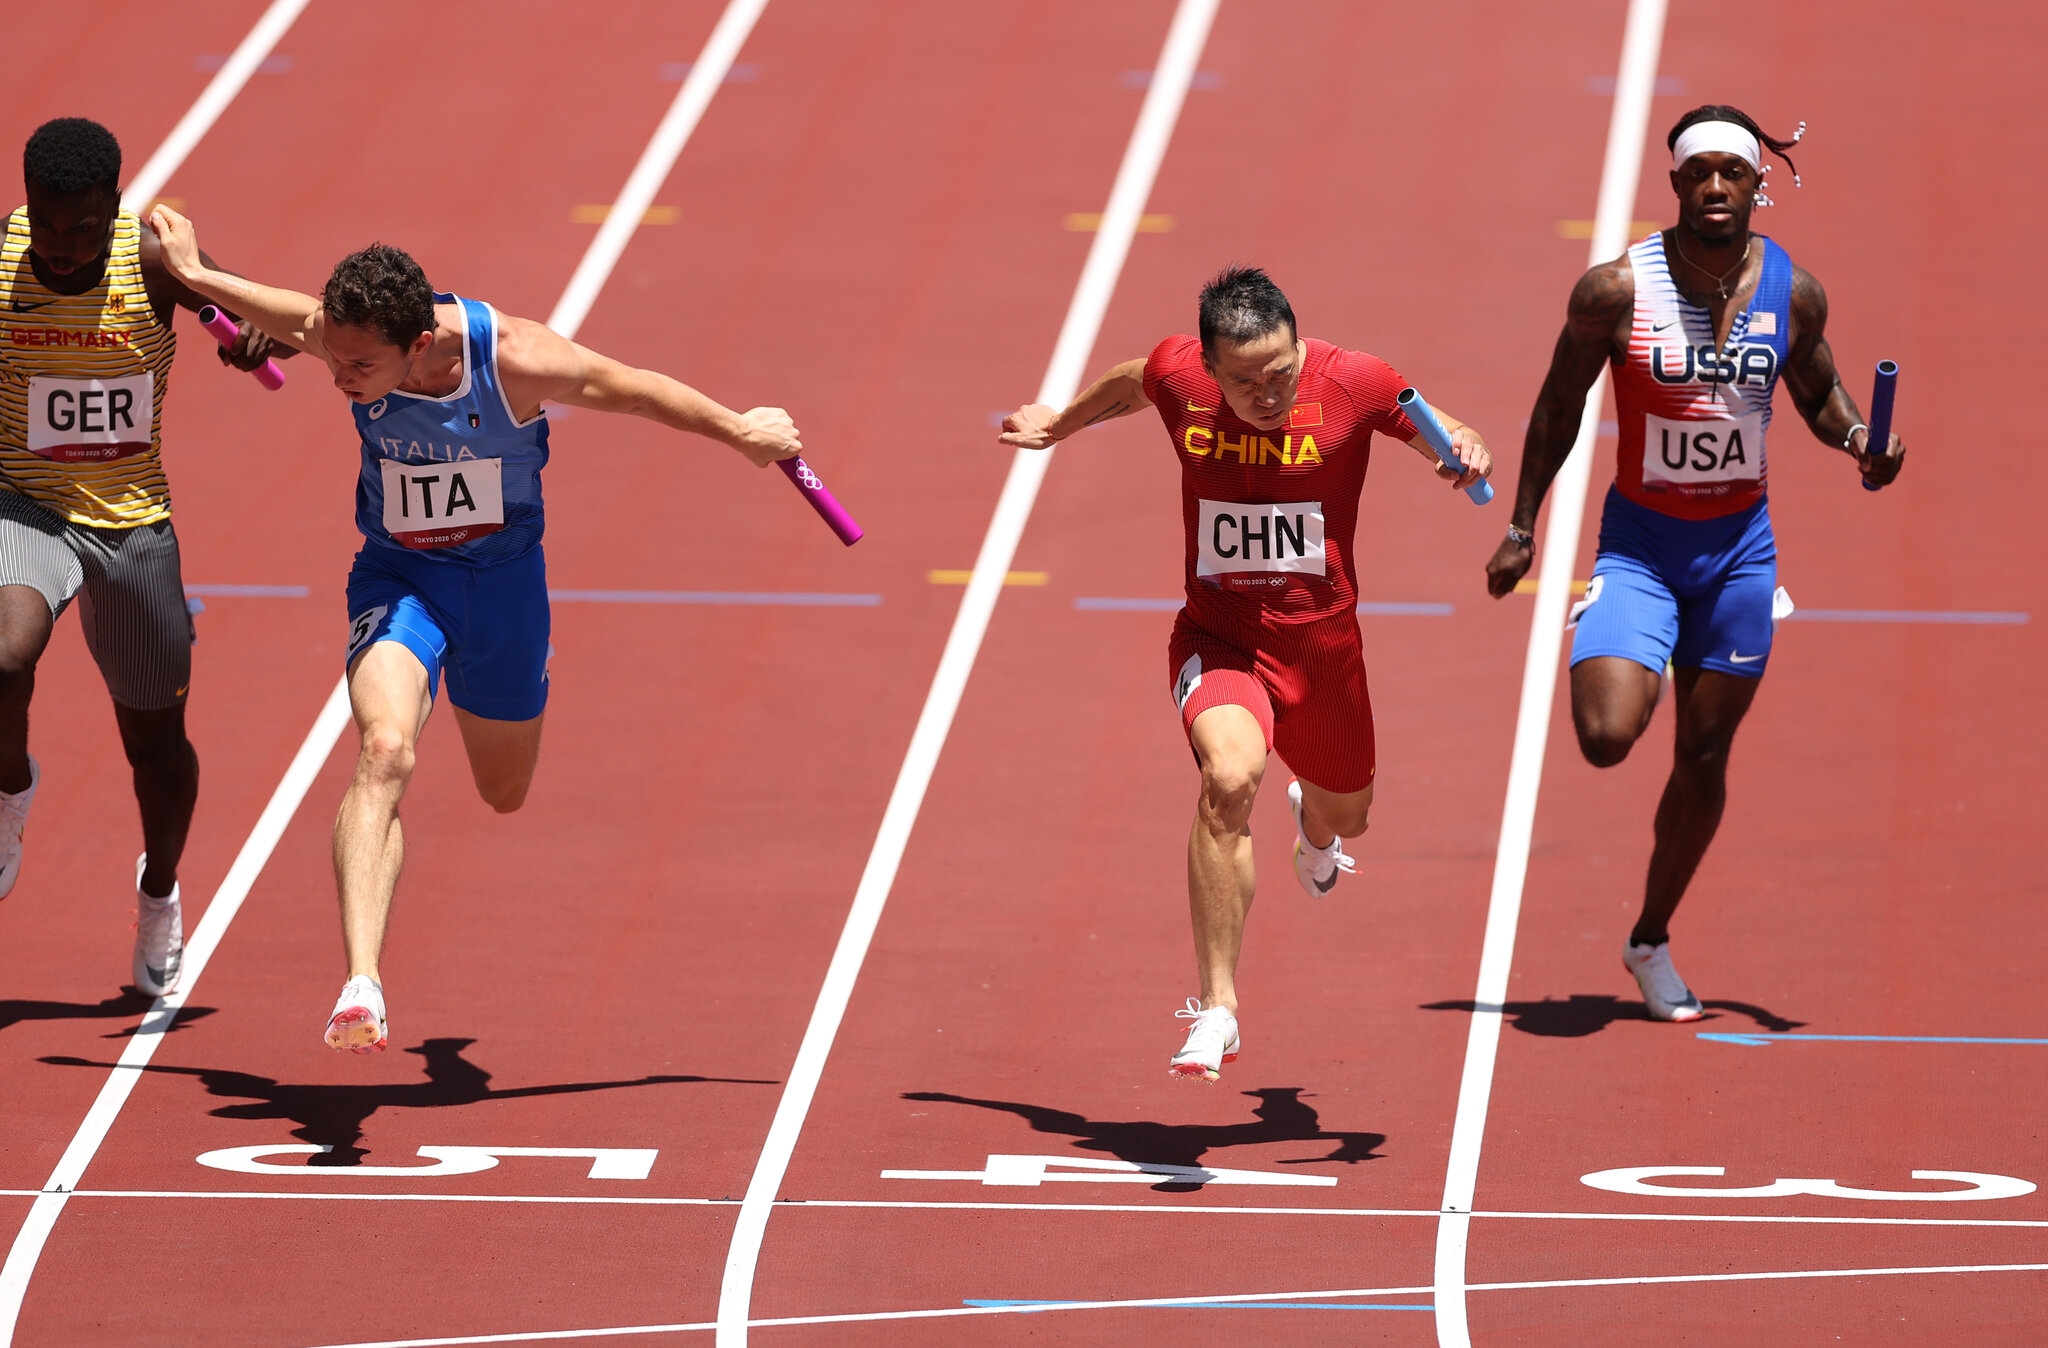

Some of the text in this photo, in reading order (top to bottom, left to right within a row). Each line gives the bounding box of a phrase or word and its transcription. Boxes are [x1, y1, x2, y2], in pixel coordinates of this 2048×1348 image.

[11, 328, 133, 348] GERMANY
[1652, 344, 1777, 386] USA
[47, 389, 134, 432] GER
[380, 436, 478, 462] ITALIA
[1185, 425, 1324, 465] CHINA
[1661, 428, 1746, 472] USA
[400, 472, 477, 518] ITA
[434, 535, 450, 543] 2020
[1213, 513, 1306, 560] CHN
[1231, 578, 1251, 586] TOKYO
[349, 610, 374, 651] 5
[196, 1143, 659, 1179] 5
[880, 1154, 1338, 1186] 4
[1579, 1165, 2037, 1201] 3
